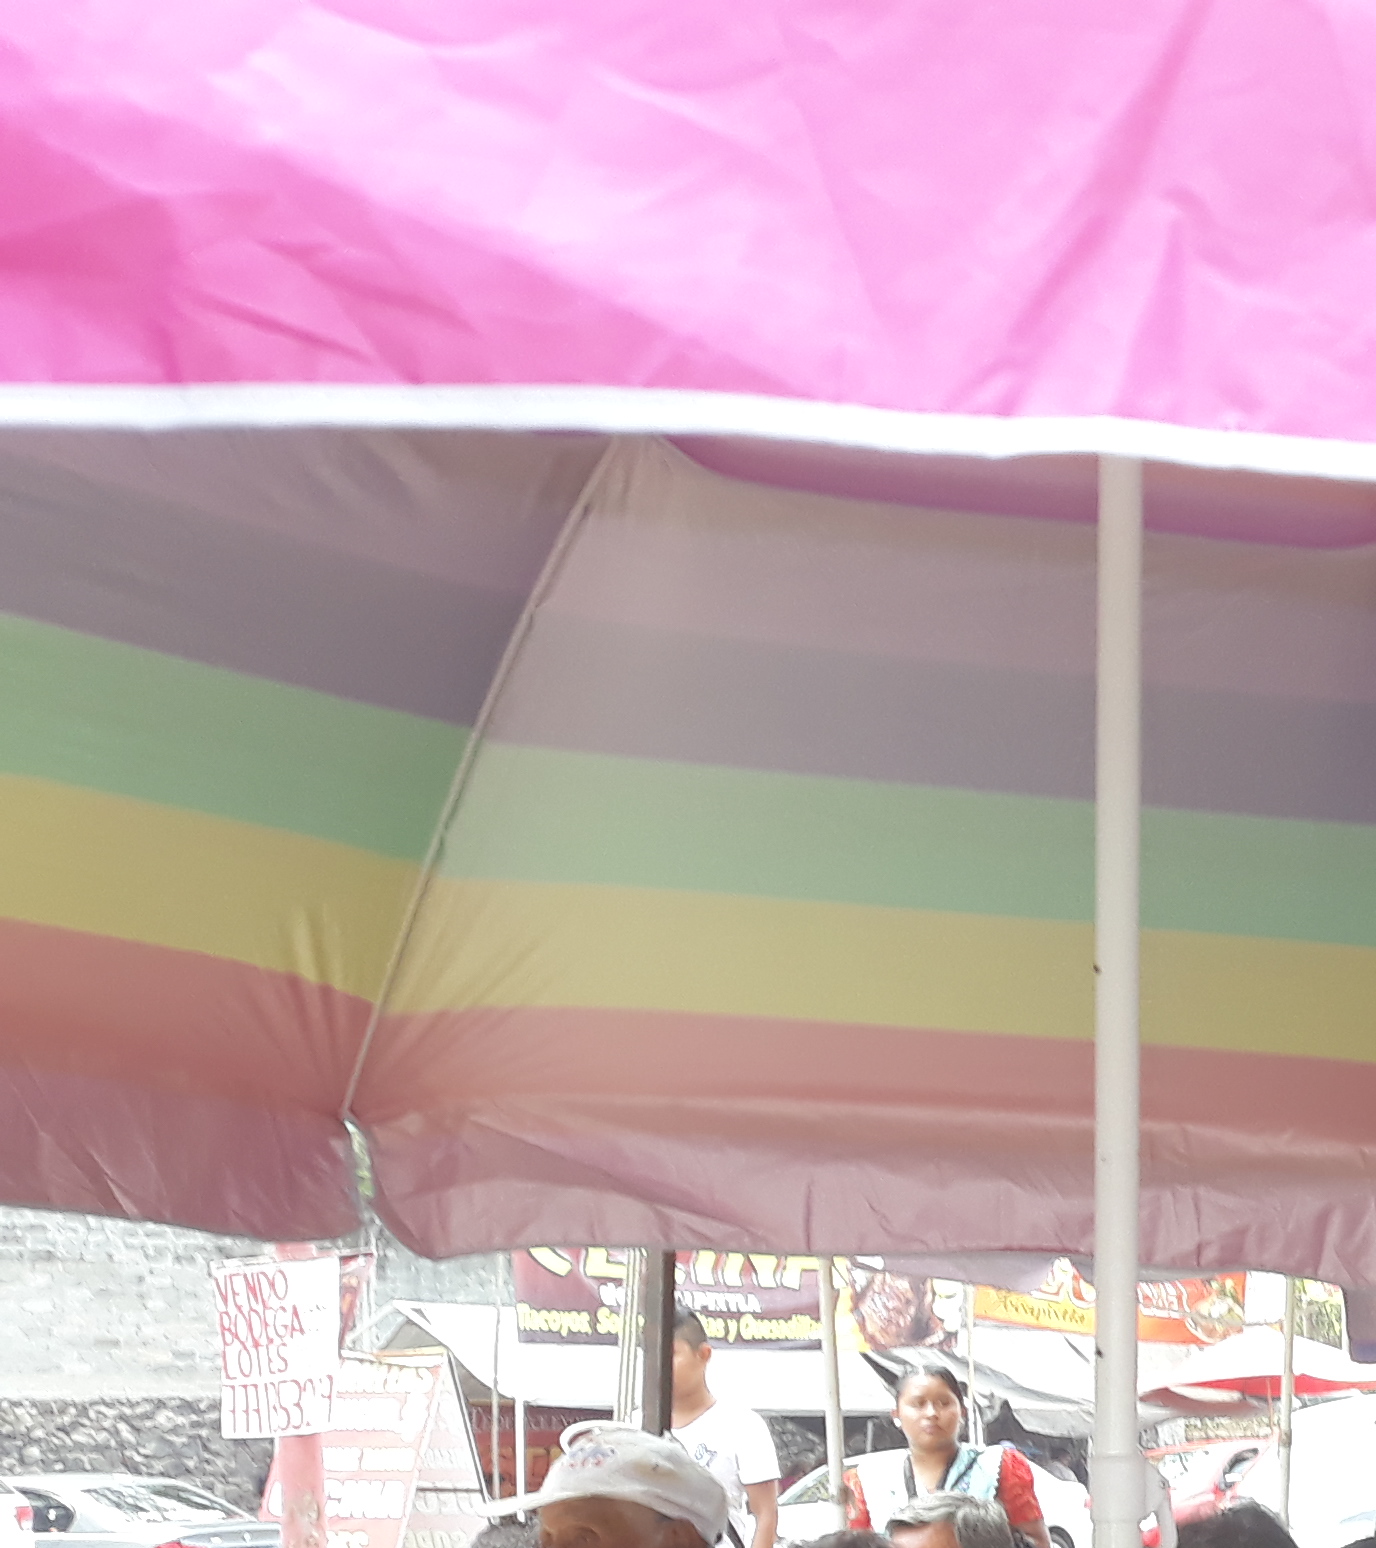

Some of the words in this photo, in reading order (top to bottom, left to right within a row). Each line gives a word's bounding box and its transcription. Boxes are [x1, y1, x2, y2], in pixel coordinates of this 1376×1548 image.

[214, 1269, 289, 1310] VENDO
[220, 1304, 306, 1347] BODEGA
[222, 1341, 289, 1380] LOTES
